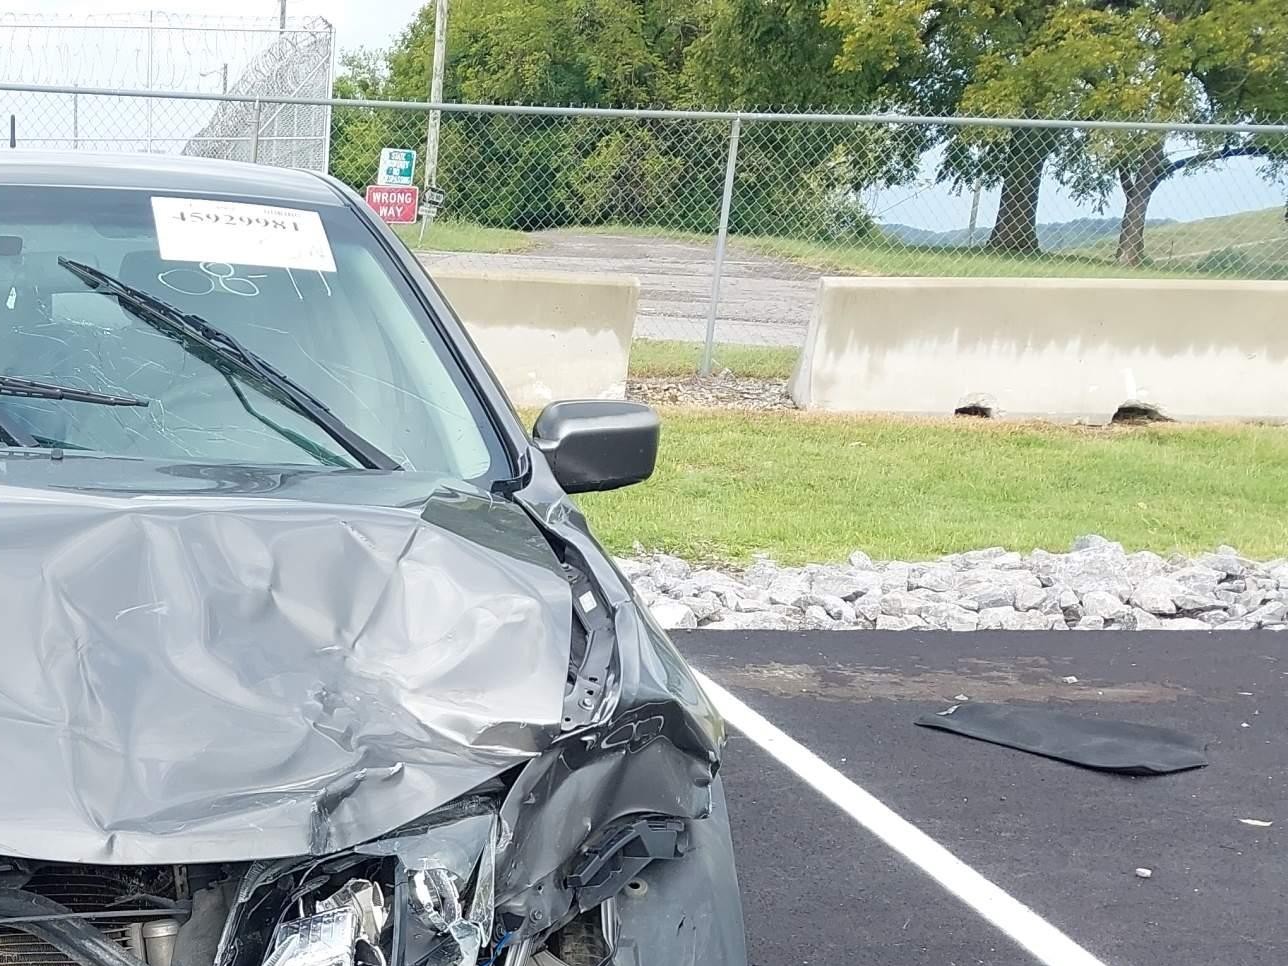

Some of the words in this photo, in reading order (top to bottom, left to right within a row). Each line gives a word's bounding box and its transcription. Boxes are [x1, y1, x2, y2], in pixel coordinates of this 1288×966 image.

[372, 191, 412, 204] WRONG
[379, 206, 404, 217] WAY
[170, 210, 300, 232] 45929981
